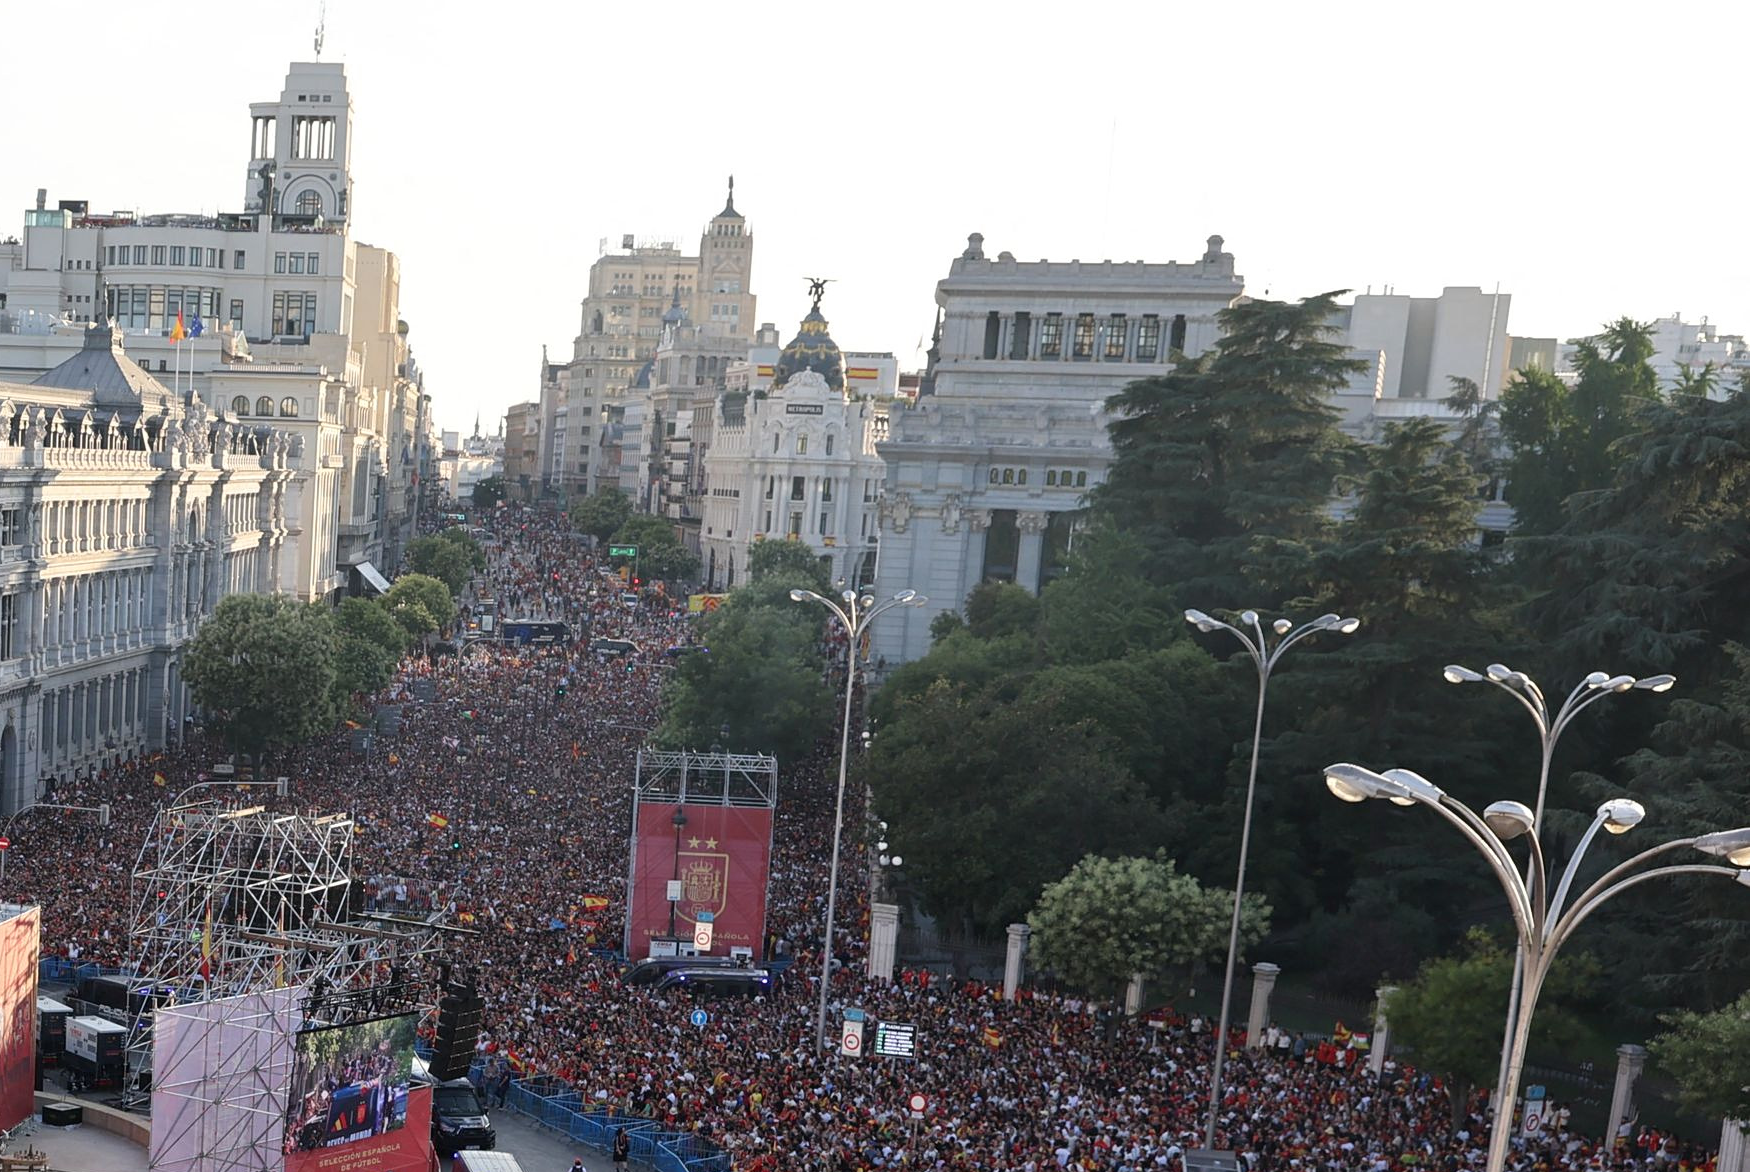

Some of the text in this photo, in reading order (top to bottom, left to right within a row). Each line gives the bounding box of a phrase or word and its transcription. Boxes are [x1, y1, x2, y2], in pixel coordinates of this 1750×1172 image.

[319, 1142, 401, 1168] SELECCIÓN ESPAÑOLA
[341, 1157, 382, 1172] DE FÚTBOL
